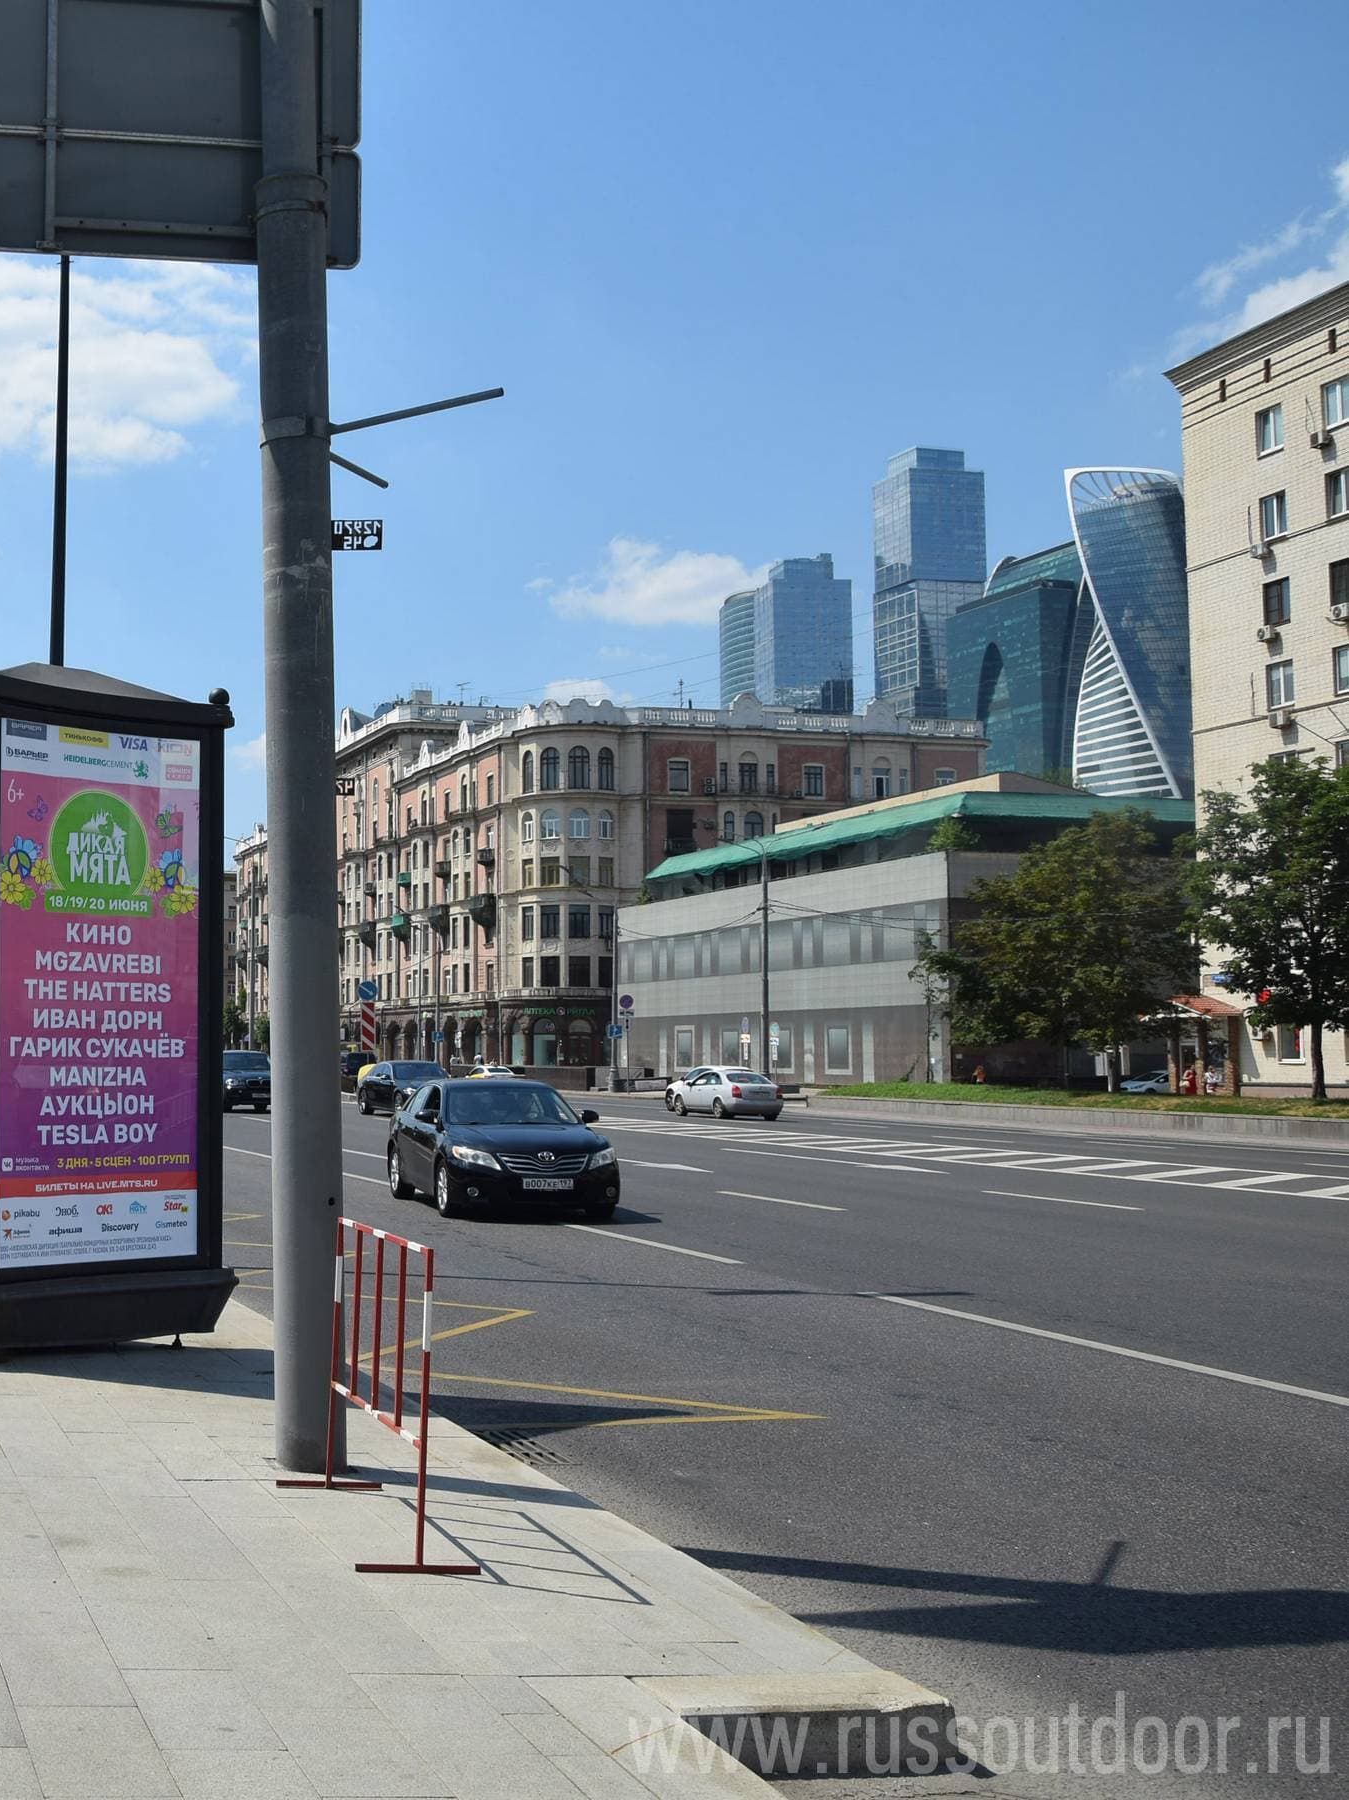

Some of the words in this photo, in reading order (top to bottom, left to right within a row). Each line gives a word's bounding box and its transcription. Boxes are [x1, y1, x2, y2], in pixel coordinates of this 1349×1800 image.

[119, 736, 149, 751] VISA
[63, 754, 134, 769] HEIDELBERGCEMENT
[7, 779, 25, 803] 6+
[66, 832, 125, 855] ДИКАЯ
[69, 852, 131, 886] МЯТА
[49, 896, 105, 911] 18/19/20
[109, 898, 148, 912] ИЮНЯ
[66, 922, 132, 945] КИНО
[35, 950, 162, 975] MGZAVREBI
[24, 978, 68, 1000] THE
[73, 979, 172, 1003] HATTERS
[33, 1008, 96, 1029] ИВАН
[101, 1010, 163, 1034] ДОРН
[9, 1036, 82, 1057] ГАРИК
[86, 1033, 185, 1058] СУКАЧЁВ
[50, 1066, 147, 1087] MANIZHA
[40, 1092, 155, 1119] АУКЦЫОН
[37, 1124, 110, 1146] TESLA
[114, 1123, 158, 1144] BOY
[57, 1158, 64, 1168] 3
[65, 1157, 89, 1170] ДНЯ
[95, 1157, 101, 1168] 5
[101, 1156, 131, 1168] СЦЕН
[138, 1155, 156, 1166] 100
[157, 1154, 190, 1165] ГРУПП
[35, 1181, 79, 1193] БИЛЕТЫ
[81, 1181, 95, 1192] НА
[96, 1179, 159, 1191] LIVE.MTS.RU
[14, 1208, 41, 1220] pikabu
[155, 1219, 188, 1230] Gismeteo
[48, 1226, 83, 1238] афиша
[101, 1222, 139, 1234] Discovery
